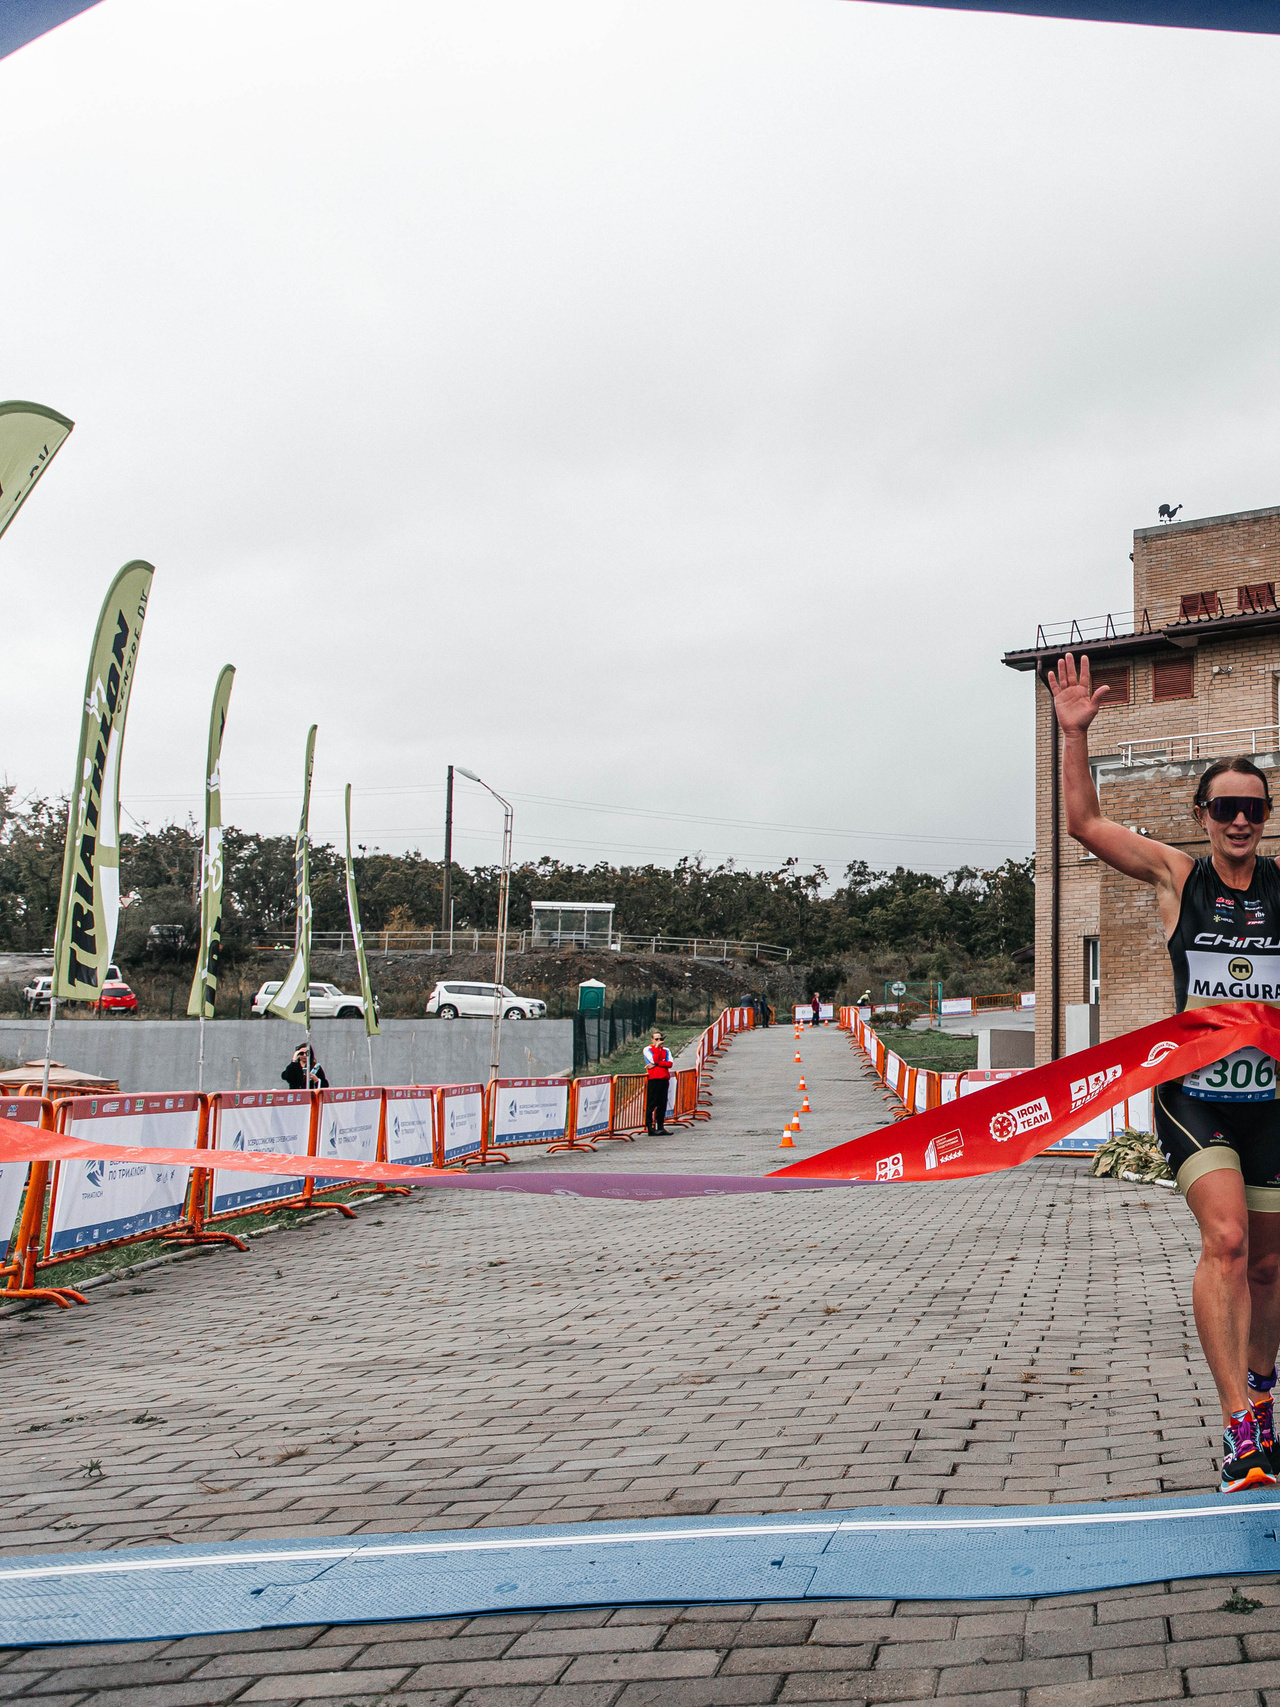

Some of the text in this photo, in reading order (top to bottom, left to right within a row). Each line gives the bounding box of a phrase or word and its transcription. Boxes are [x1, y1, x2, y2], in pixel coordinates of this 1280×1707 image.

[68, 608, 130, 988] TRIATHLON
[1206, 1055, 1274, 1089] 306
[1017, 1102, 1043, 1119] IRON
[1020, 1112, 1050, 1130] TEAM
